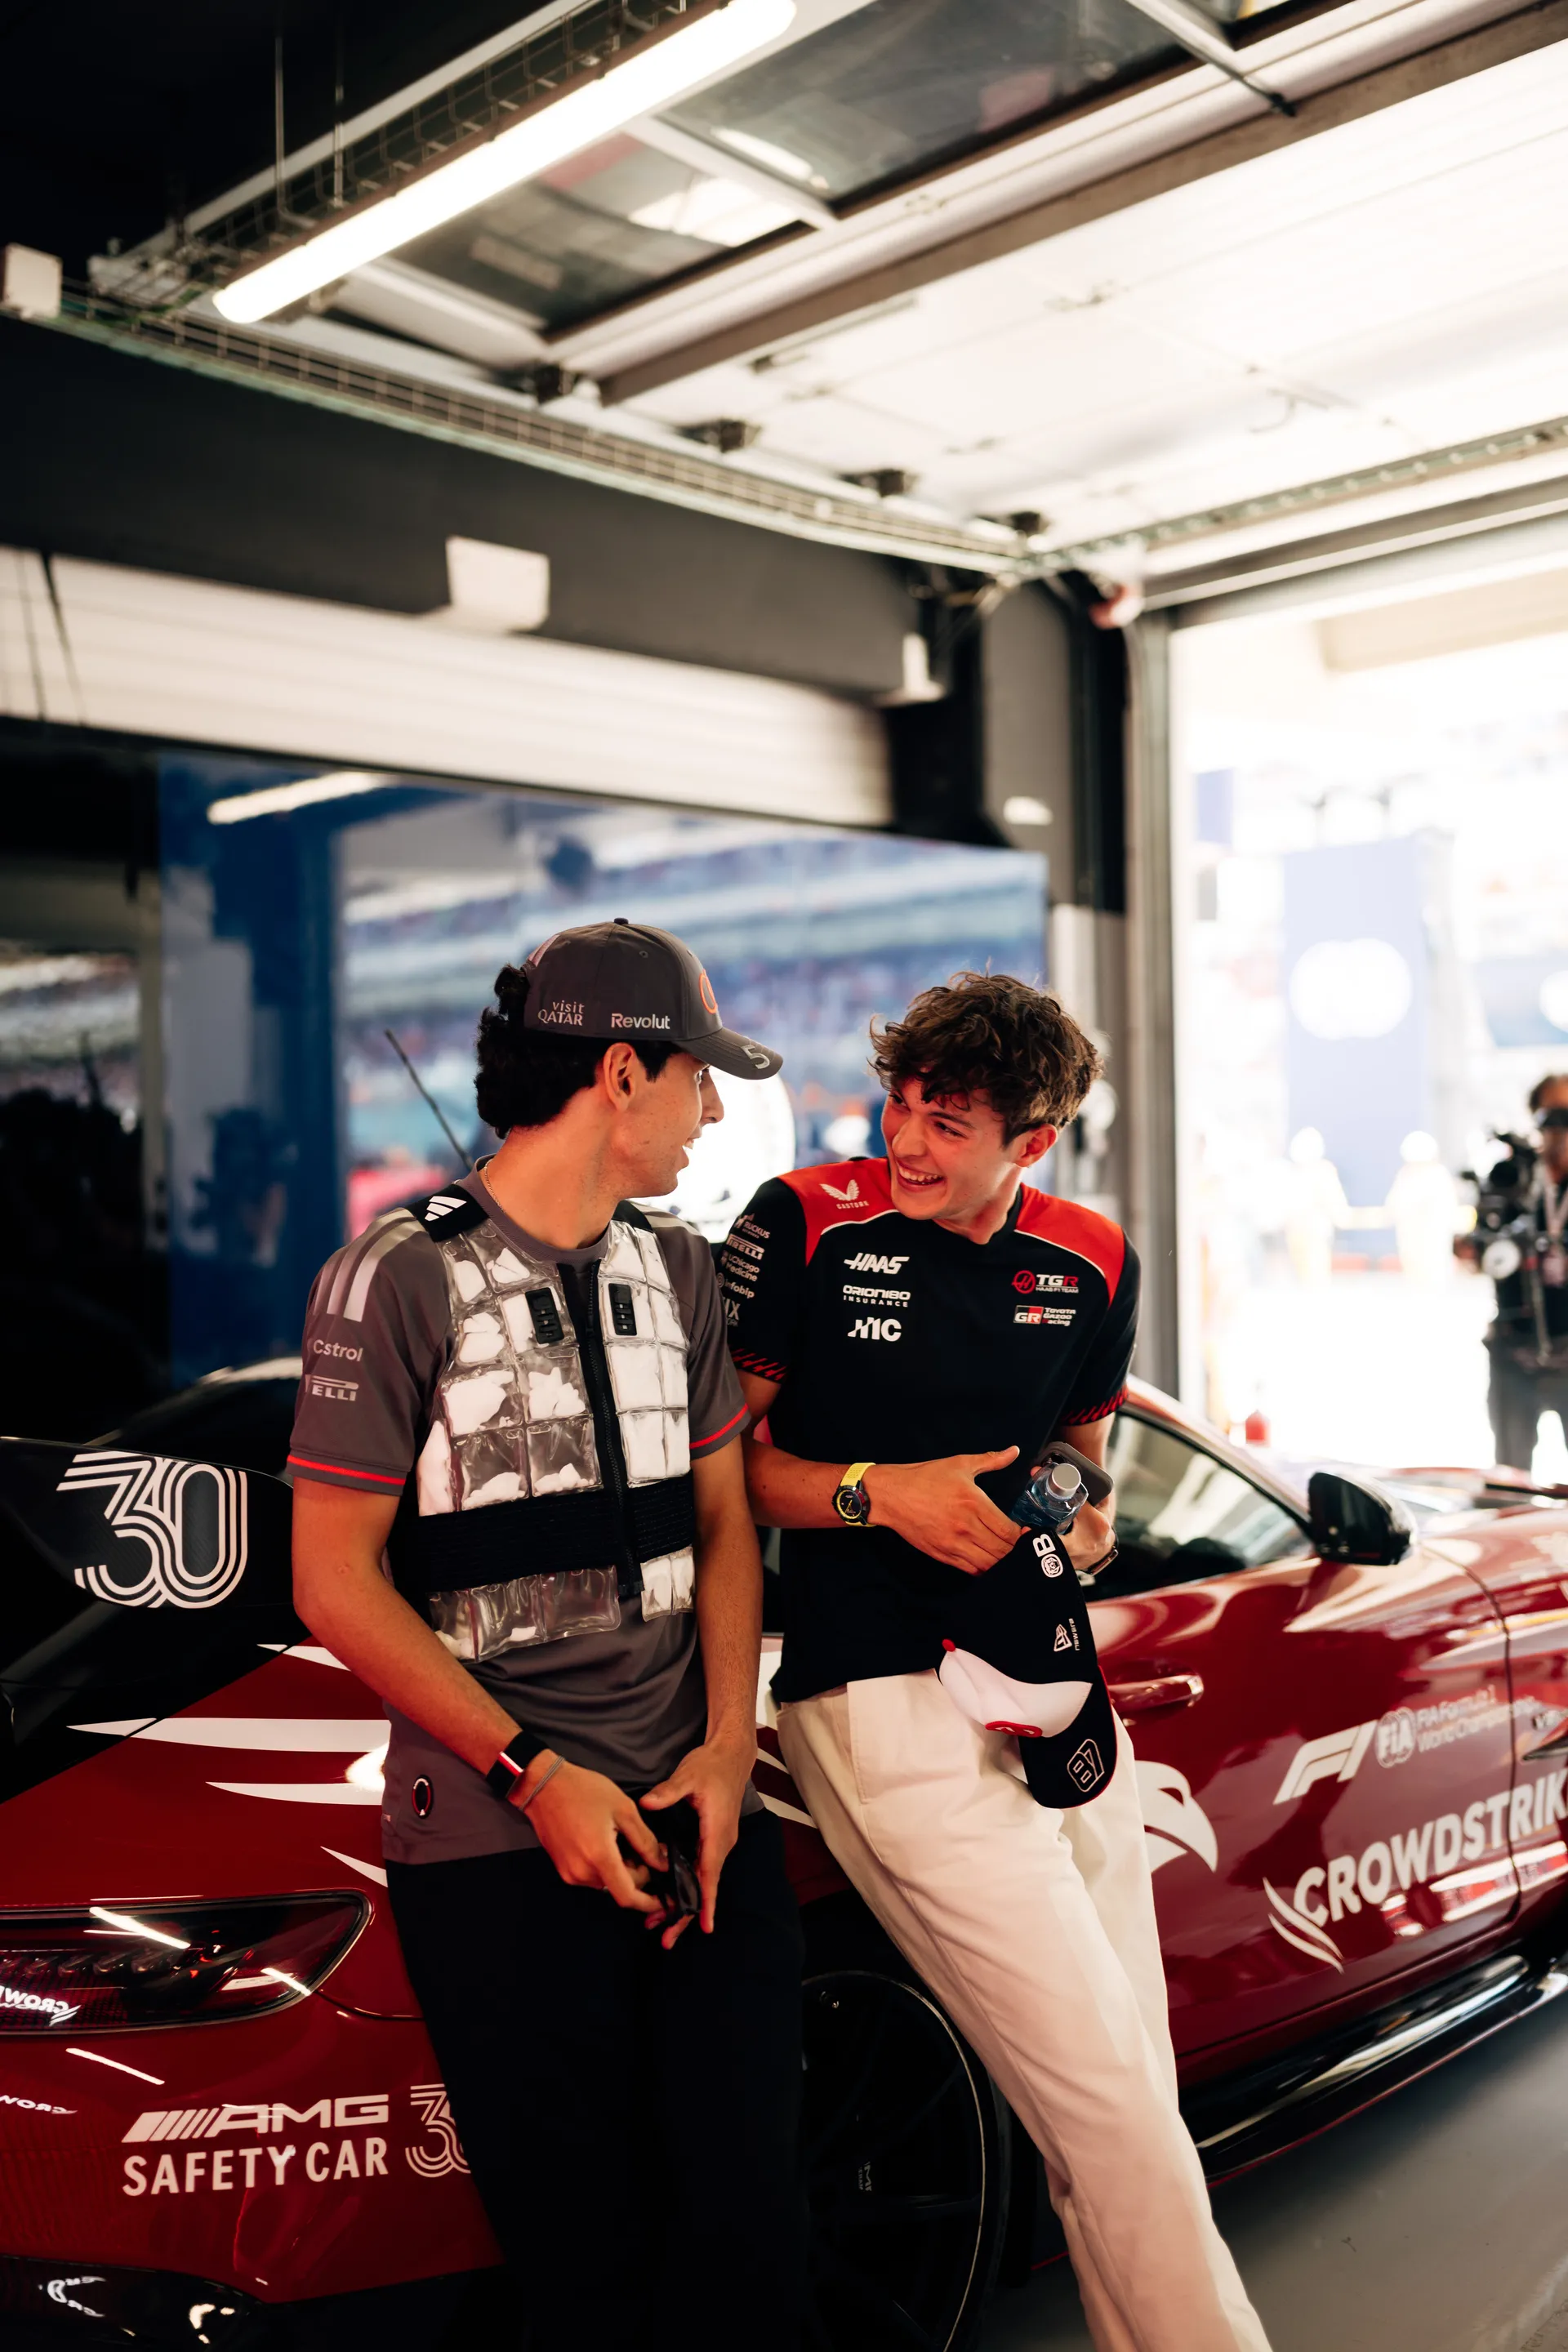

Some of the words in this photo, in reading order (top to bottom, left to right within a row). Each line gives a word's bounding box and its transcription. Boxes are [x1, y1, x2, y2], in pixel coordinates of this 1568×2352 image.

[537, 1009, 583, 1027] QATAR
[552, 1000, 585, 1014] visit
[611, 1013, 670, 1030] Revolut
[741, 1045, 770, 1070] 5
[836, 1200, 870, 1209] CASTORE
[744, 1221, 771, 1239] RUCKUS
[726, 1233, 765, 1261] PIRELLI
[725, 1262, 758, 1282] Medicine
[844, 1252, 910, 1275] HAAS
[1036, 1274, 1079, 1287] TGR
[844, 1295, 908, 1307] INSURANCE
[1014, 1312, 1041, 1323] GR
[305, 1374, 359, 1401] PELLI
[56, 1451, 248, 1609] 30
[1067, 1739, 1105, 1793] 87
[1273, 1719, 1379, 1806] F1
[1294, 1767, 1568, 1928] CROWDSTRIK
[204, 2094, 390, 2138] AMG
[122, 2145, 296, 2197] SAFETY
[305, 2136, 390, 2182] CAR
